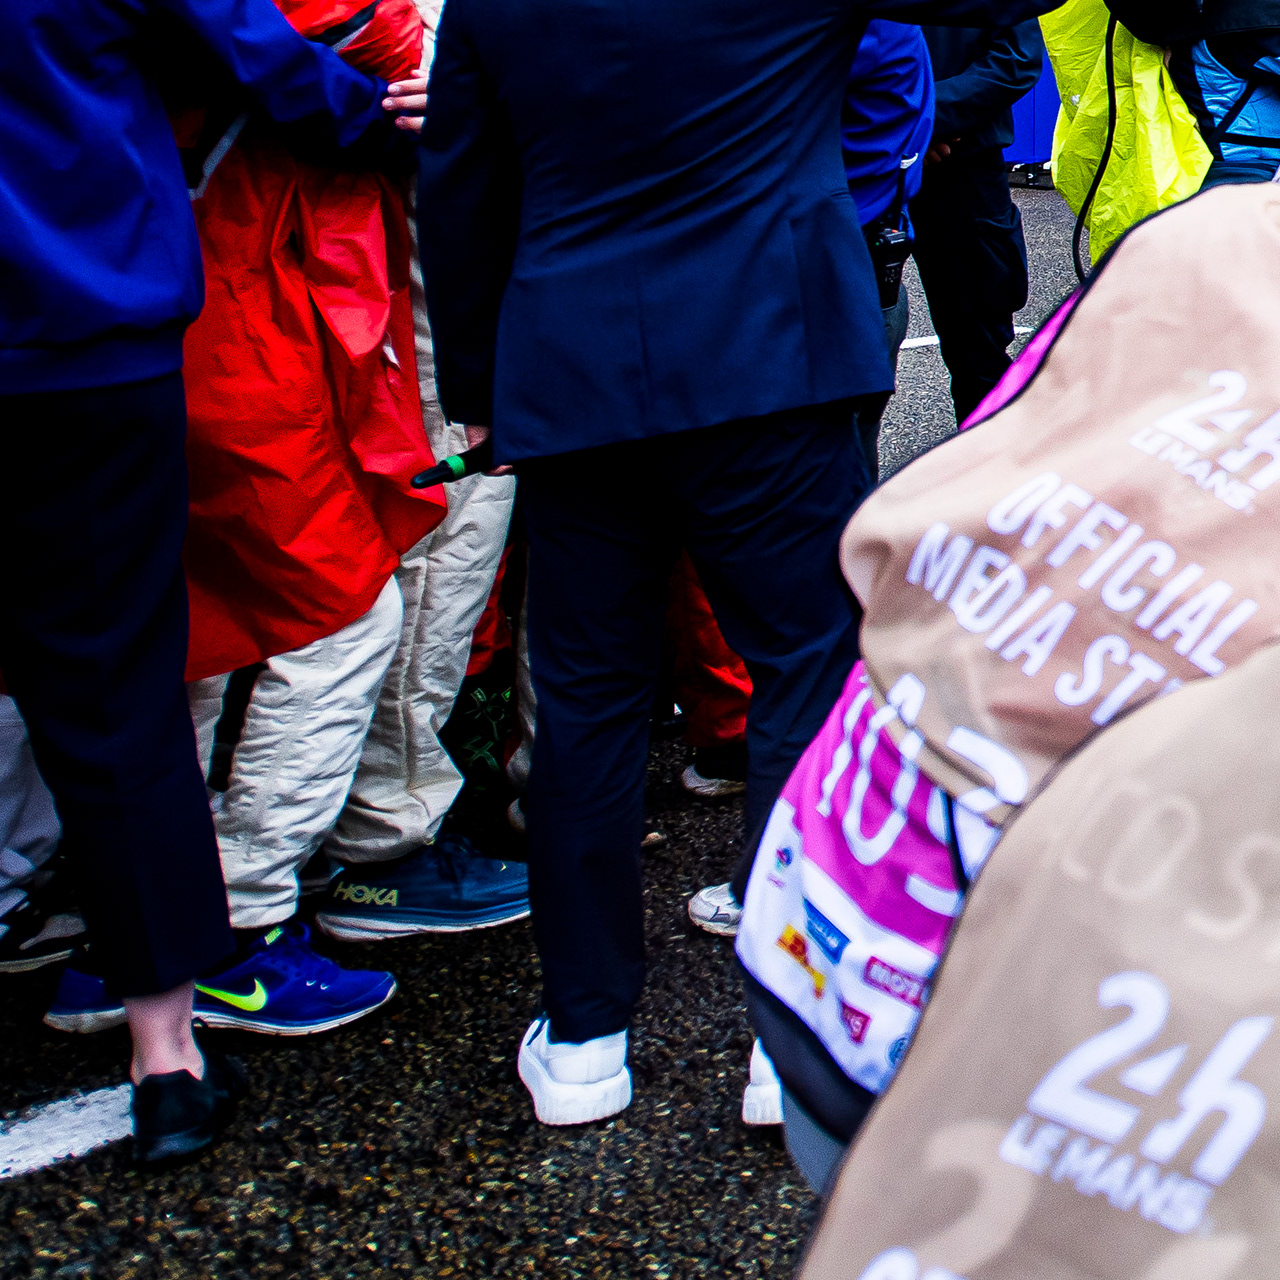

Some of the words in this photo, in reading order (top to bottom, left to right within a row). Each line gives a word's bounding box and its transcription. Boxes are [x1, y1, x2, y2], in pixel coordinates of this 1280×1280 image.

[905, 521, 1080, 678] MEDIA
[986, 470, 1259, 676] OFFICIAL
[333, 881, 399, 907] HOKA
[1026, 970, 1278, 1186] 24h
